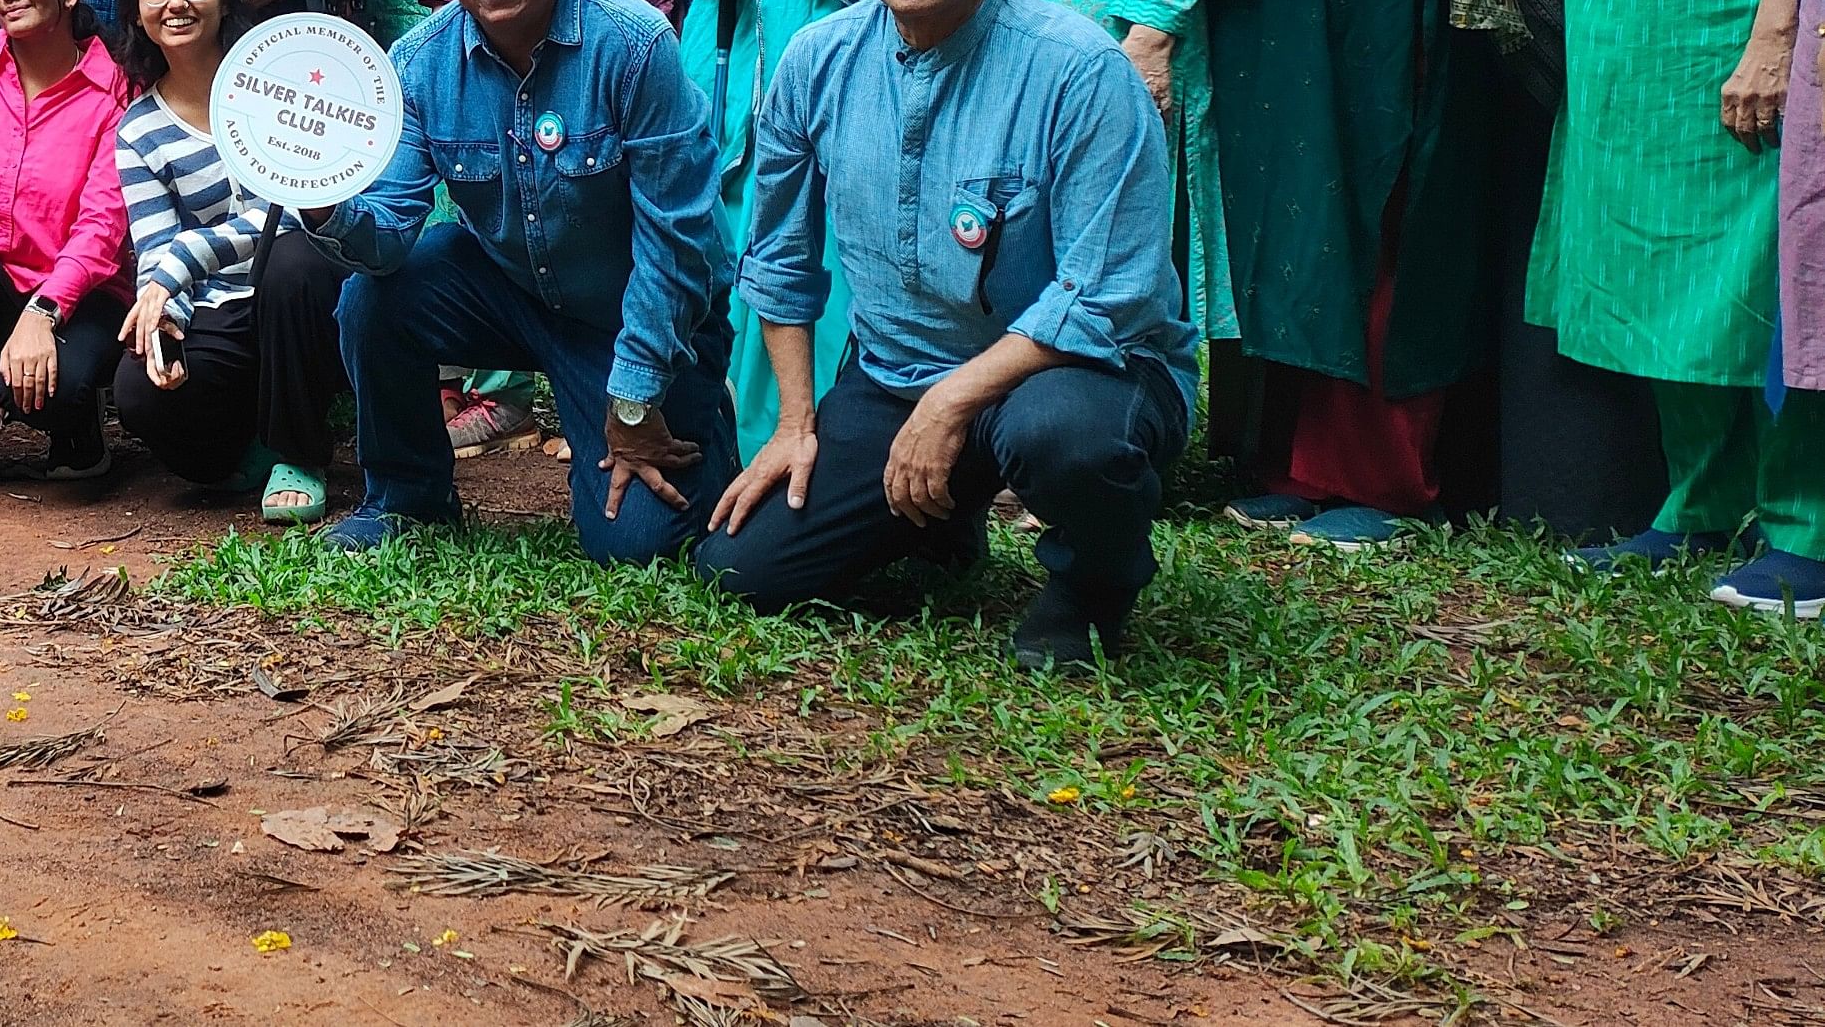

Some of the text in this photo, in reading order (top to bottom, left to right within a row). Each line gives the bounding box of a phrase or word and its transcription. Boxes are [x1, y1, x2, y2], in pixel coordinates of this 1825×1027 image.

[245, 26, 386, 104] OFFICIAL MEMBER OF THE
[233, 72, 377, 131] SILVER TALKIES
[277, 109, 326, 137] CLUB
[226, 118, 365, 189] AGED TO PERFECTION
[267, 135, 321, 161] Est. 2018
